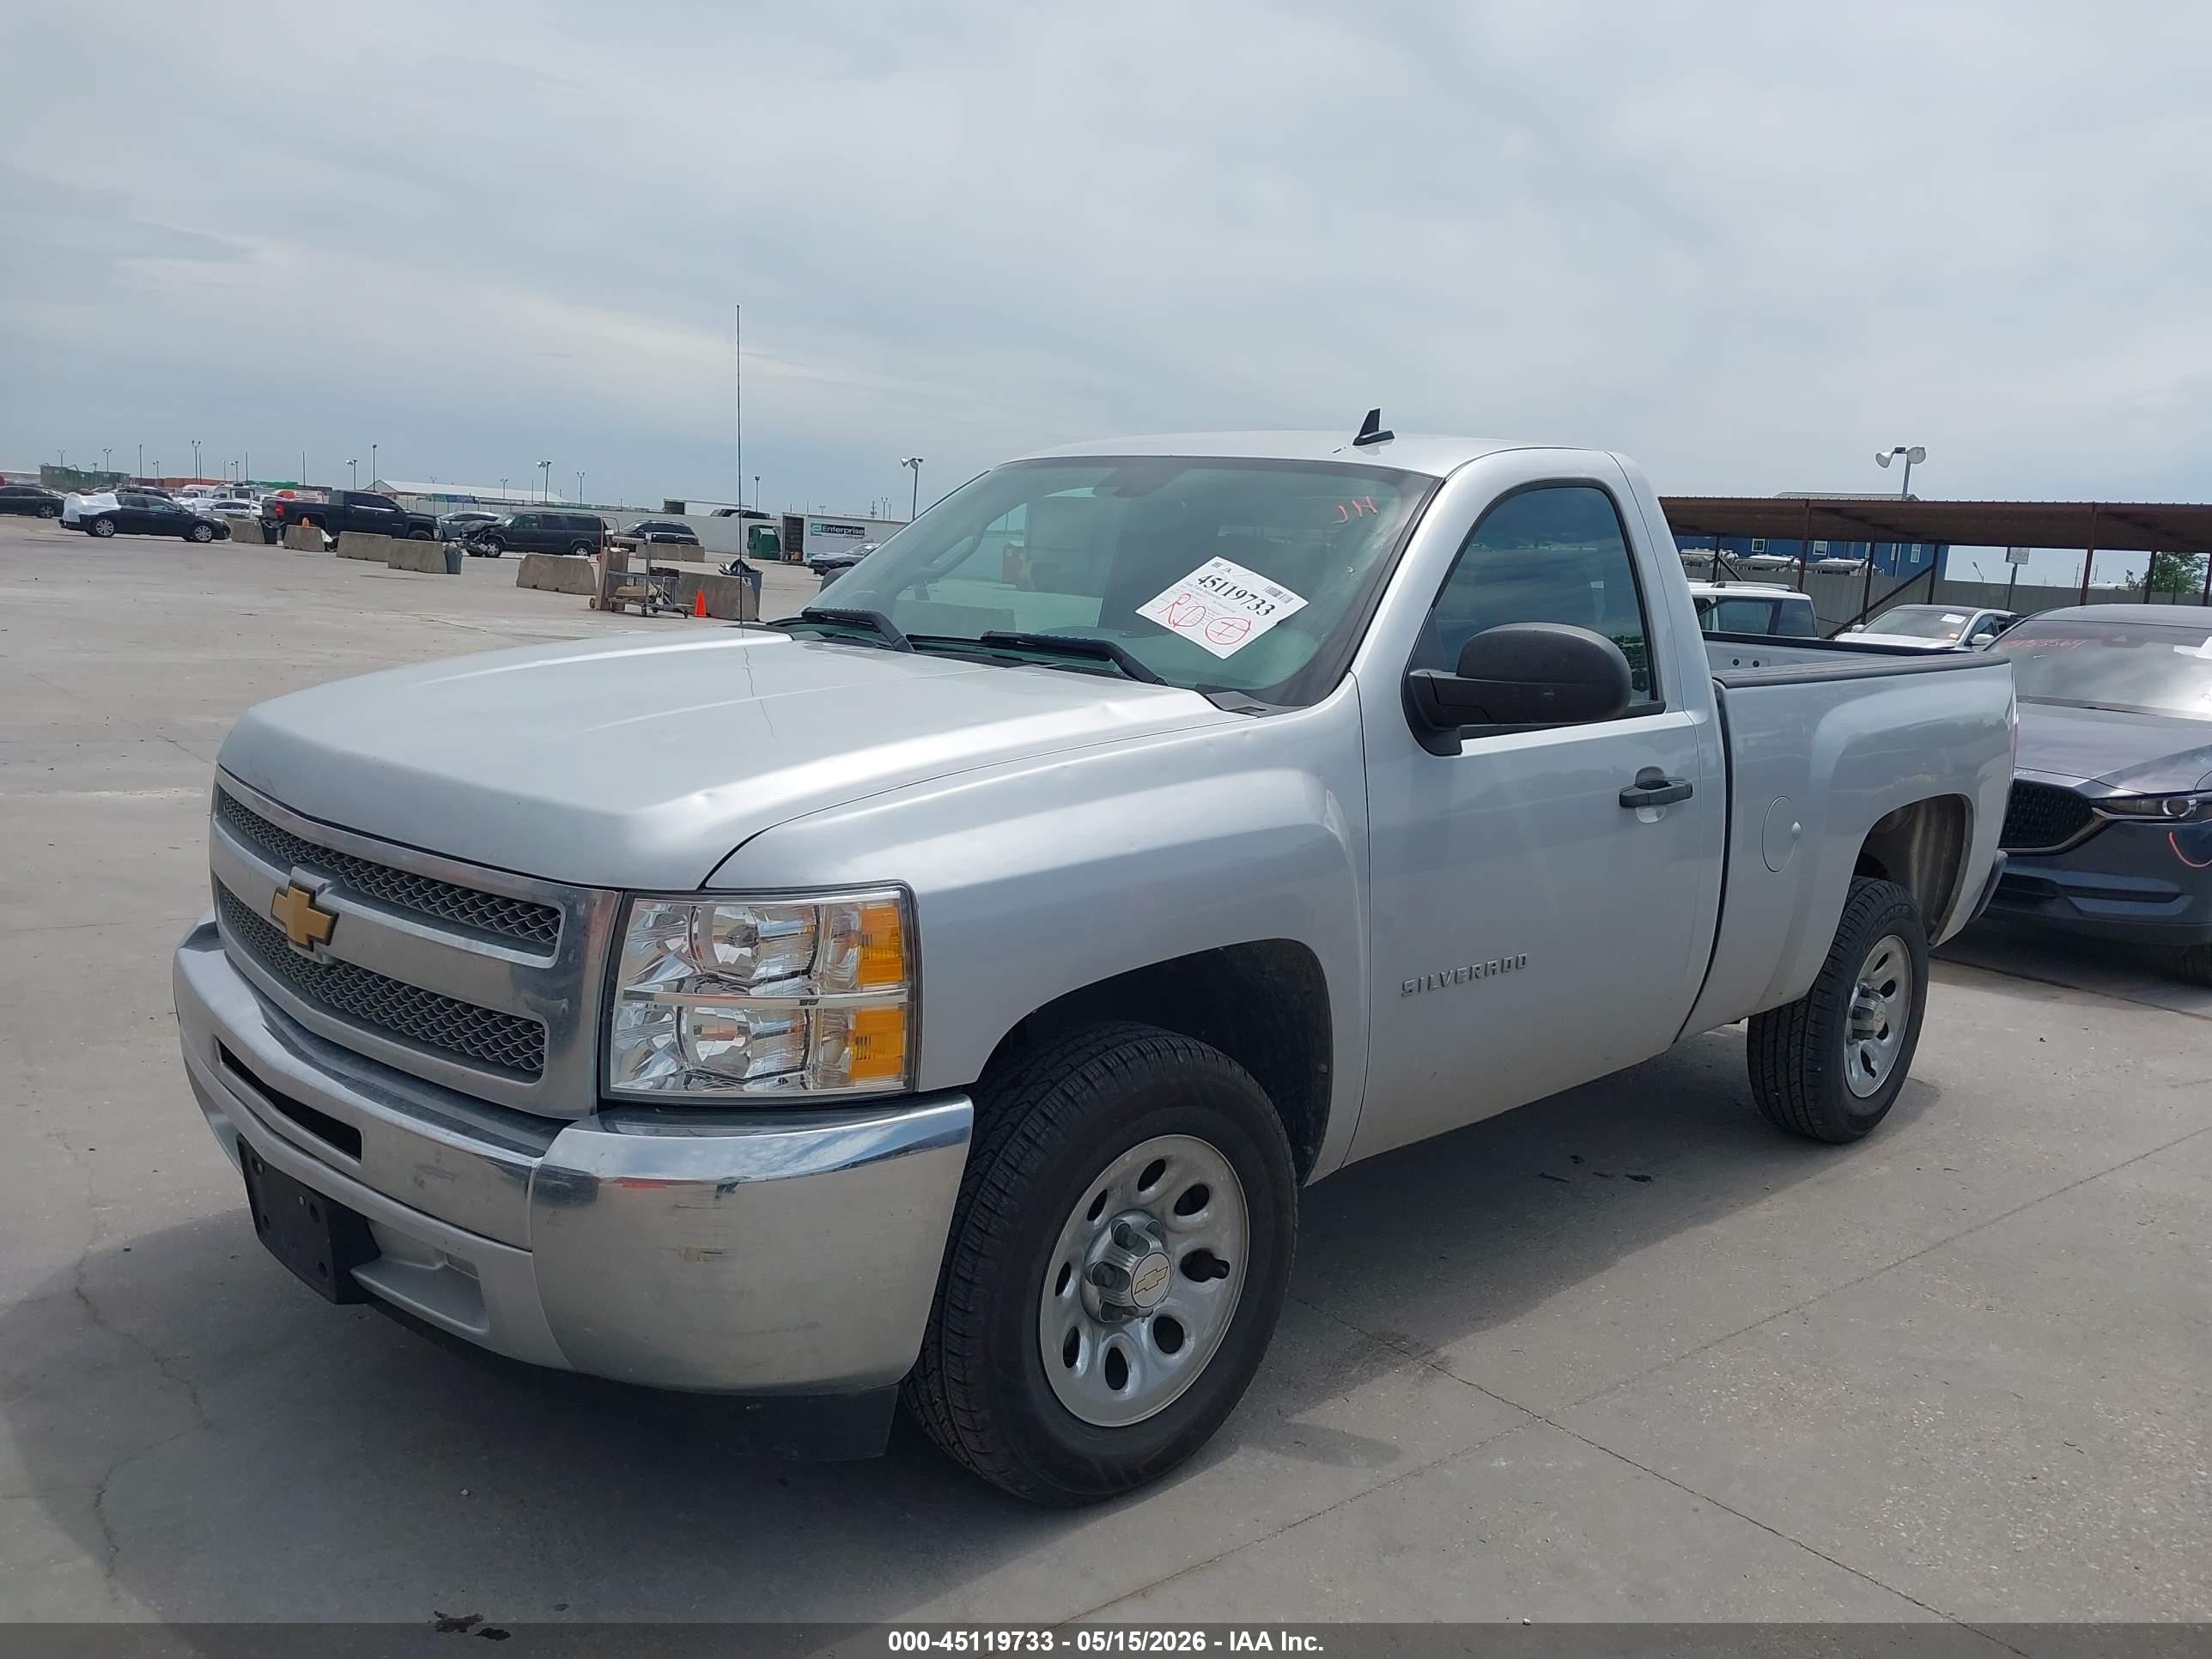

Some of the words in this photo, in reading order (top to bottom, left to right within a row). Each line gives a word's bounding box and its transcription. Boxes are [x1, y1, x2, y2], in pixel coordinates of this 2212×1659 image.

[822, 525, 865, 535] Enterprise
[1197, 574, 1276, 617] 45119733
[1401, 952, 1528, 998] SILVERADO
